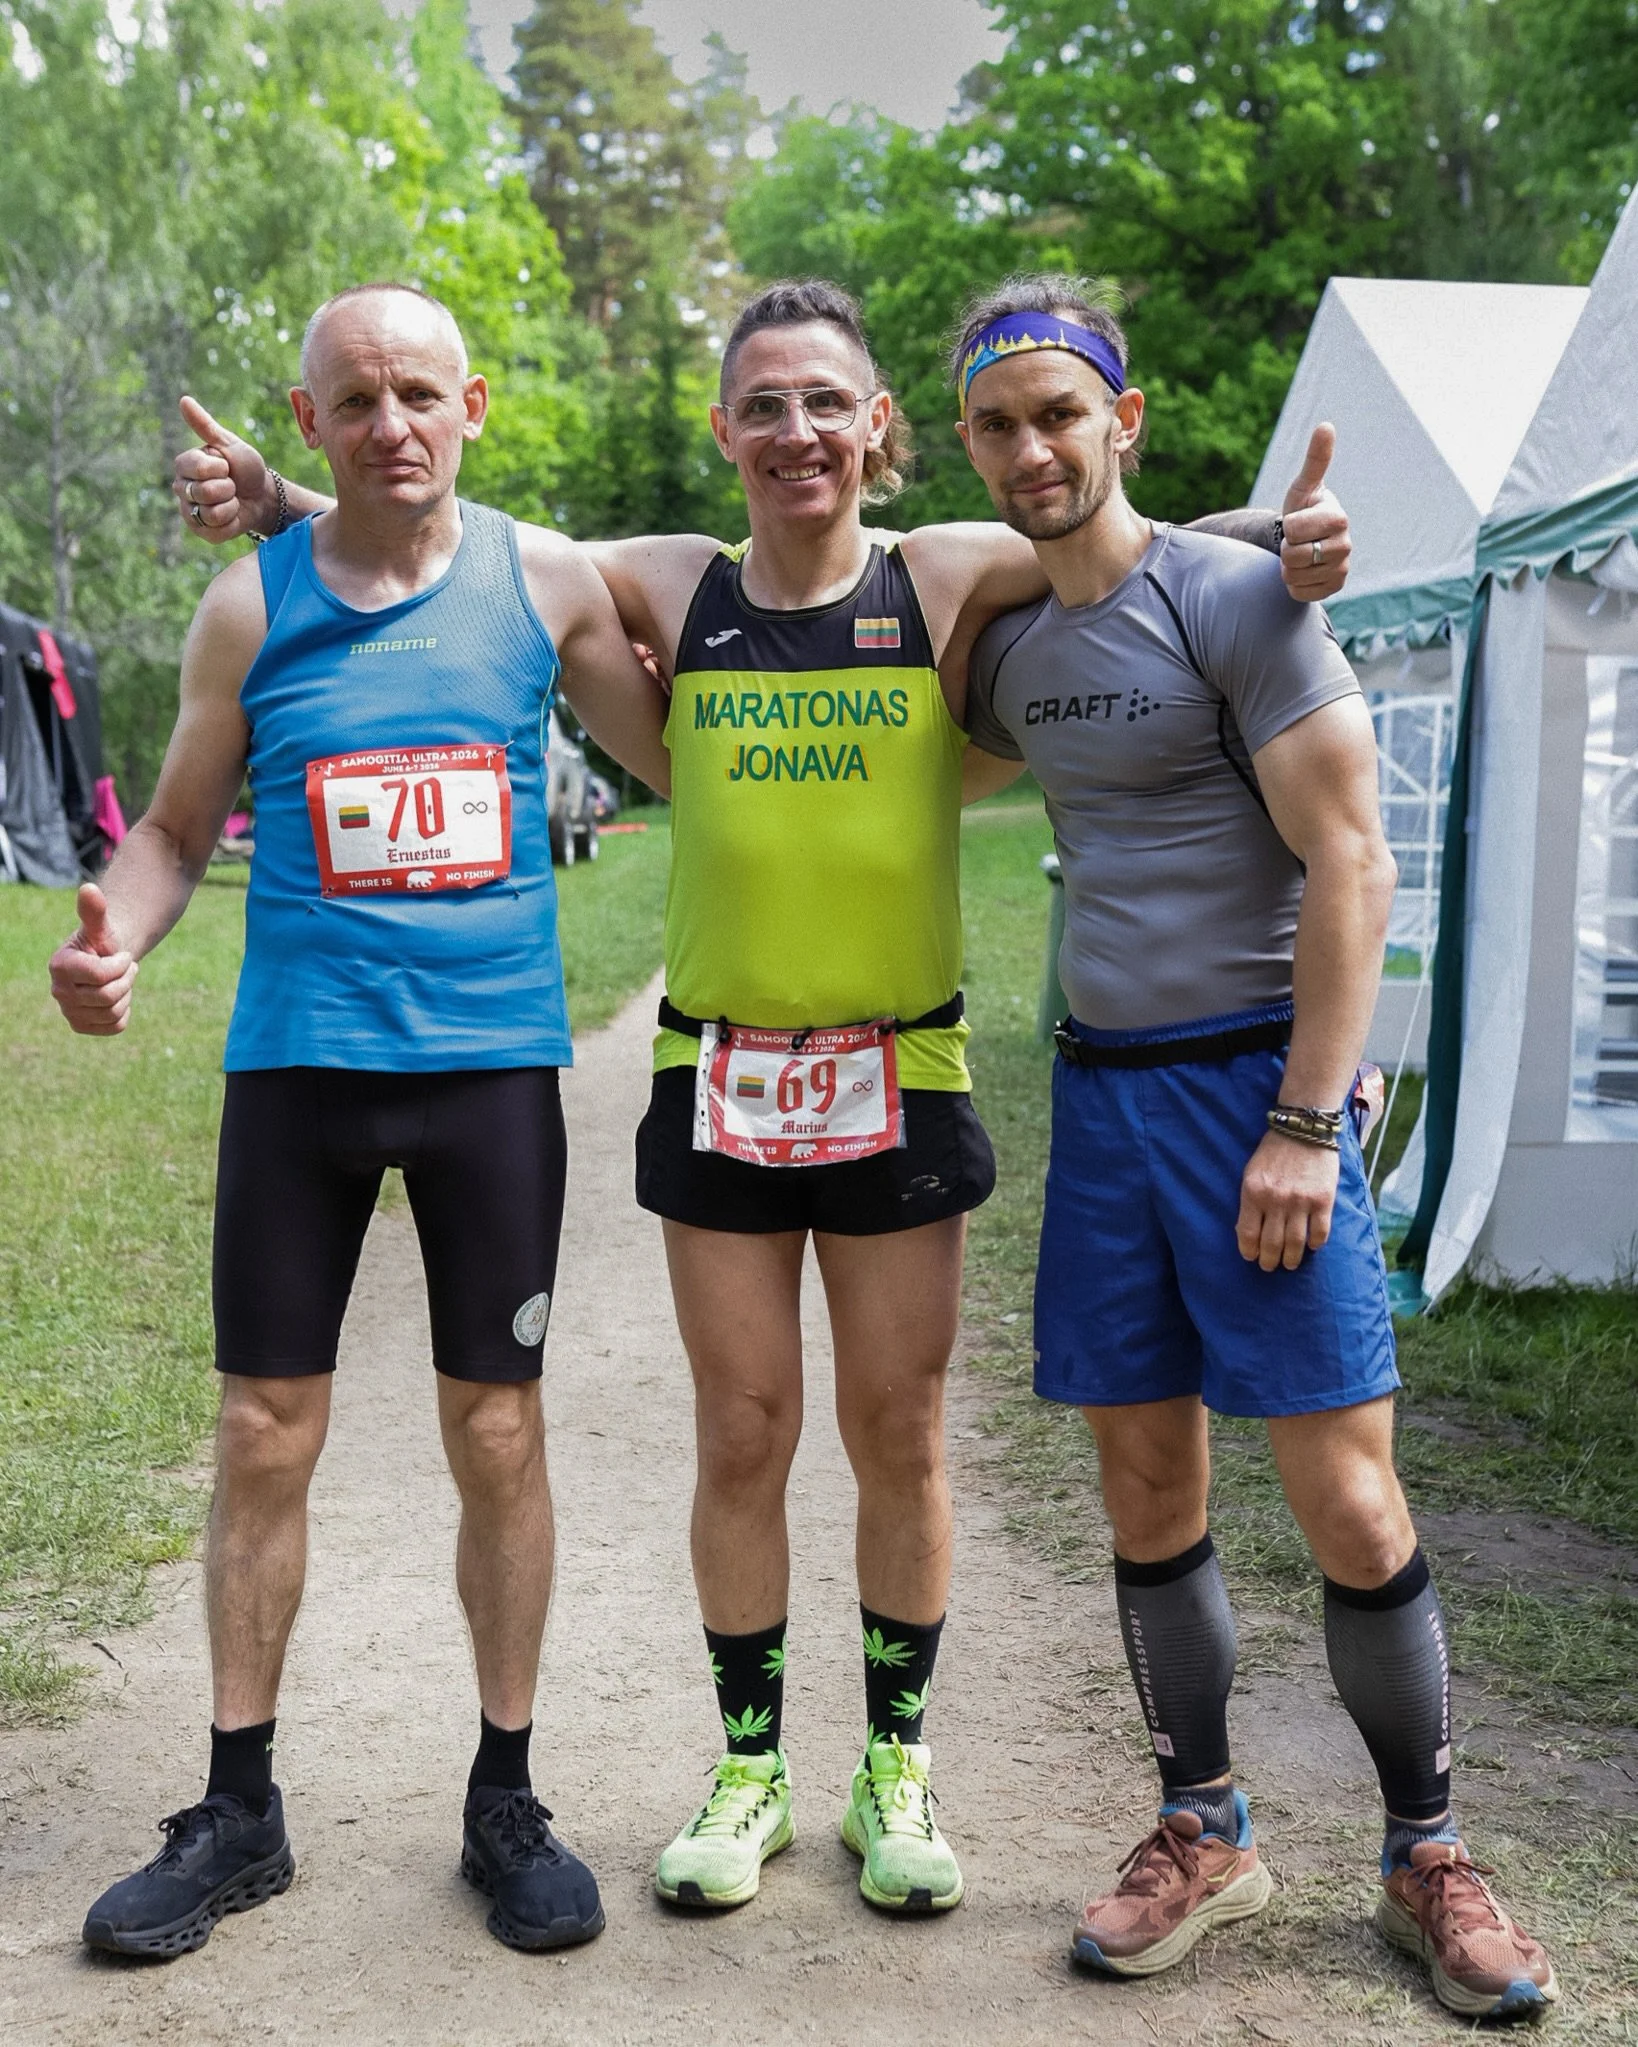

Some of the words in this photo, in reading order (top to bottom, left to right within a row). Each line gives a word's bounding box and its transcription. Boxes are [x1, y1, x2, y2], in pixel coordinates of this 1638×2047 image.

[349, 637, 437, 655] noname
[694, 688, 909, 730] MARATONAS
[1025, 693, 1122, 725] CRAFT
[341, 753, 409, 767] SAMOGITIA
[412, 751, 448, 763] ULTRA
[451, 750, 479, 760] 2026
[725, 743, 873, 782] JONAVA
[381, 776, 445, 843] 70
[387, 847, 451, 864] Ernestas
[349, 880, 378, 889] THERE
[381, 878, 393, 887] IS
[446, 872, 461, 882] NO
[463, 870, 495, 879] FINISH
[815, 1035, 845, 1045] ULTRA
[777, 1059, 837, 1115] 69
[780, 1120, 828, 1134] Marius
[766, 1146, 777, 1155] IS
[827, 1145, 842, 1153] NO
[844, 1140, 877, 1151] FINISH
[1129, 1608, 1159, 1728] COMPRESSPORT
